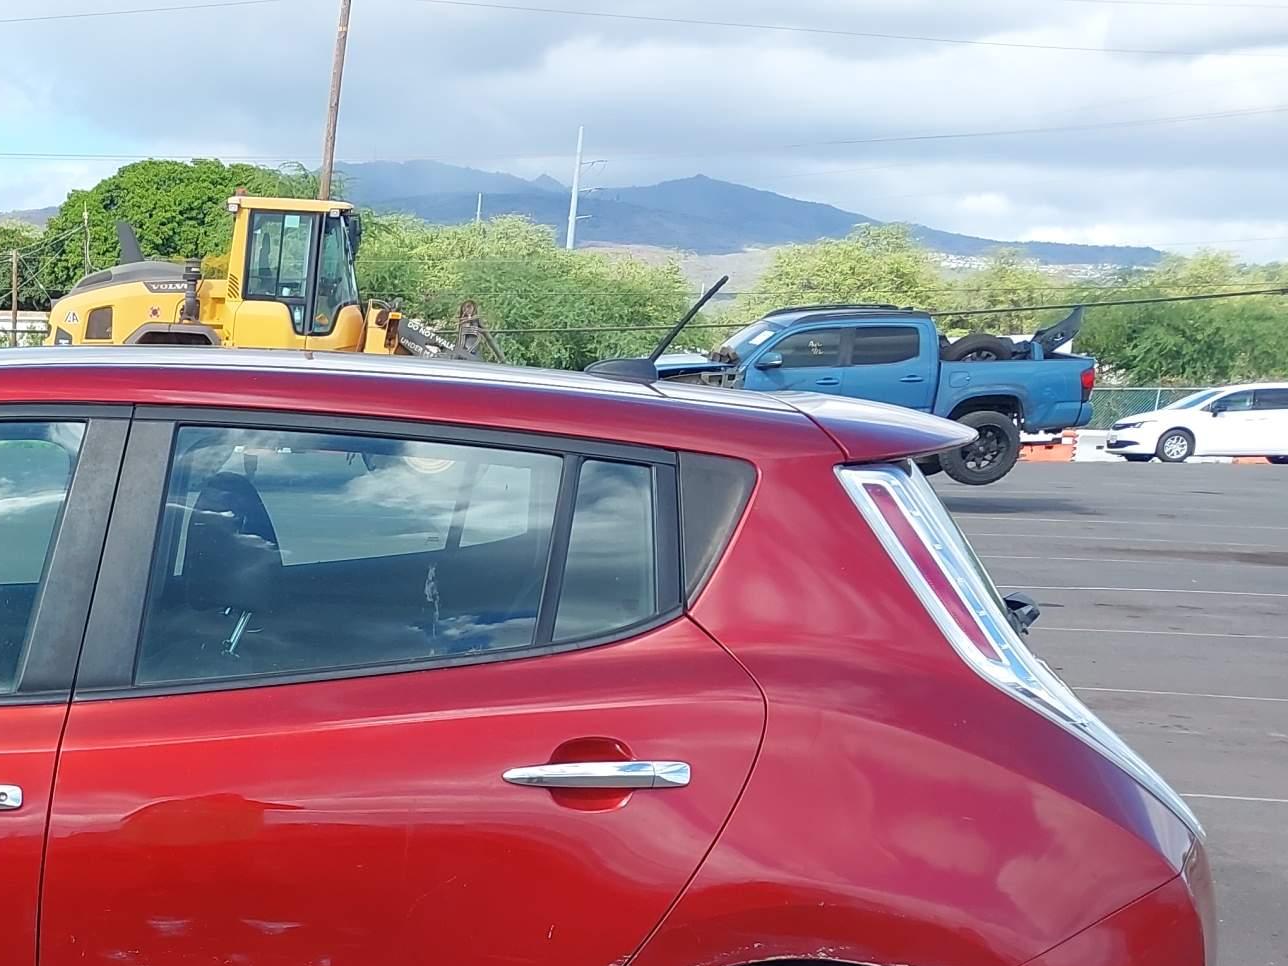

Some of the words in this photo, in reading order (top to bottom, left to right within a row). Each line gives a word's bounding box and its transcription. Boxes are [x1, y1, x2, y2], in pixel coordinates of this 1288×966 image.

[400, 336, 424, 354] UNDER
[407, 321, 419, 331] DO
[418, 327, 436, 340] NOT
[435, 335, 456, 351] WALK
